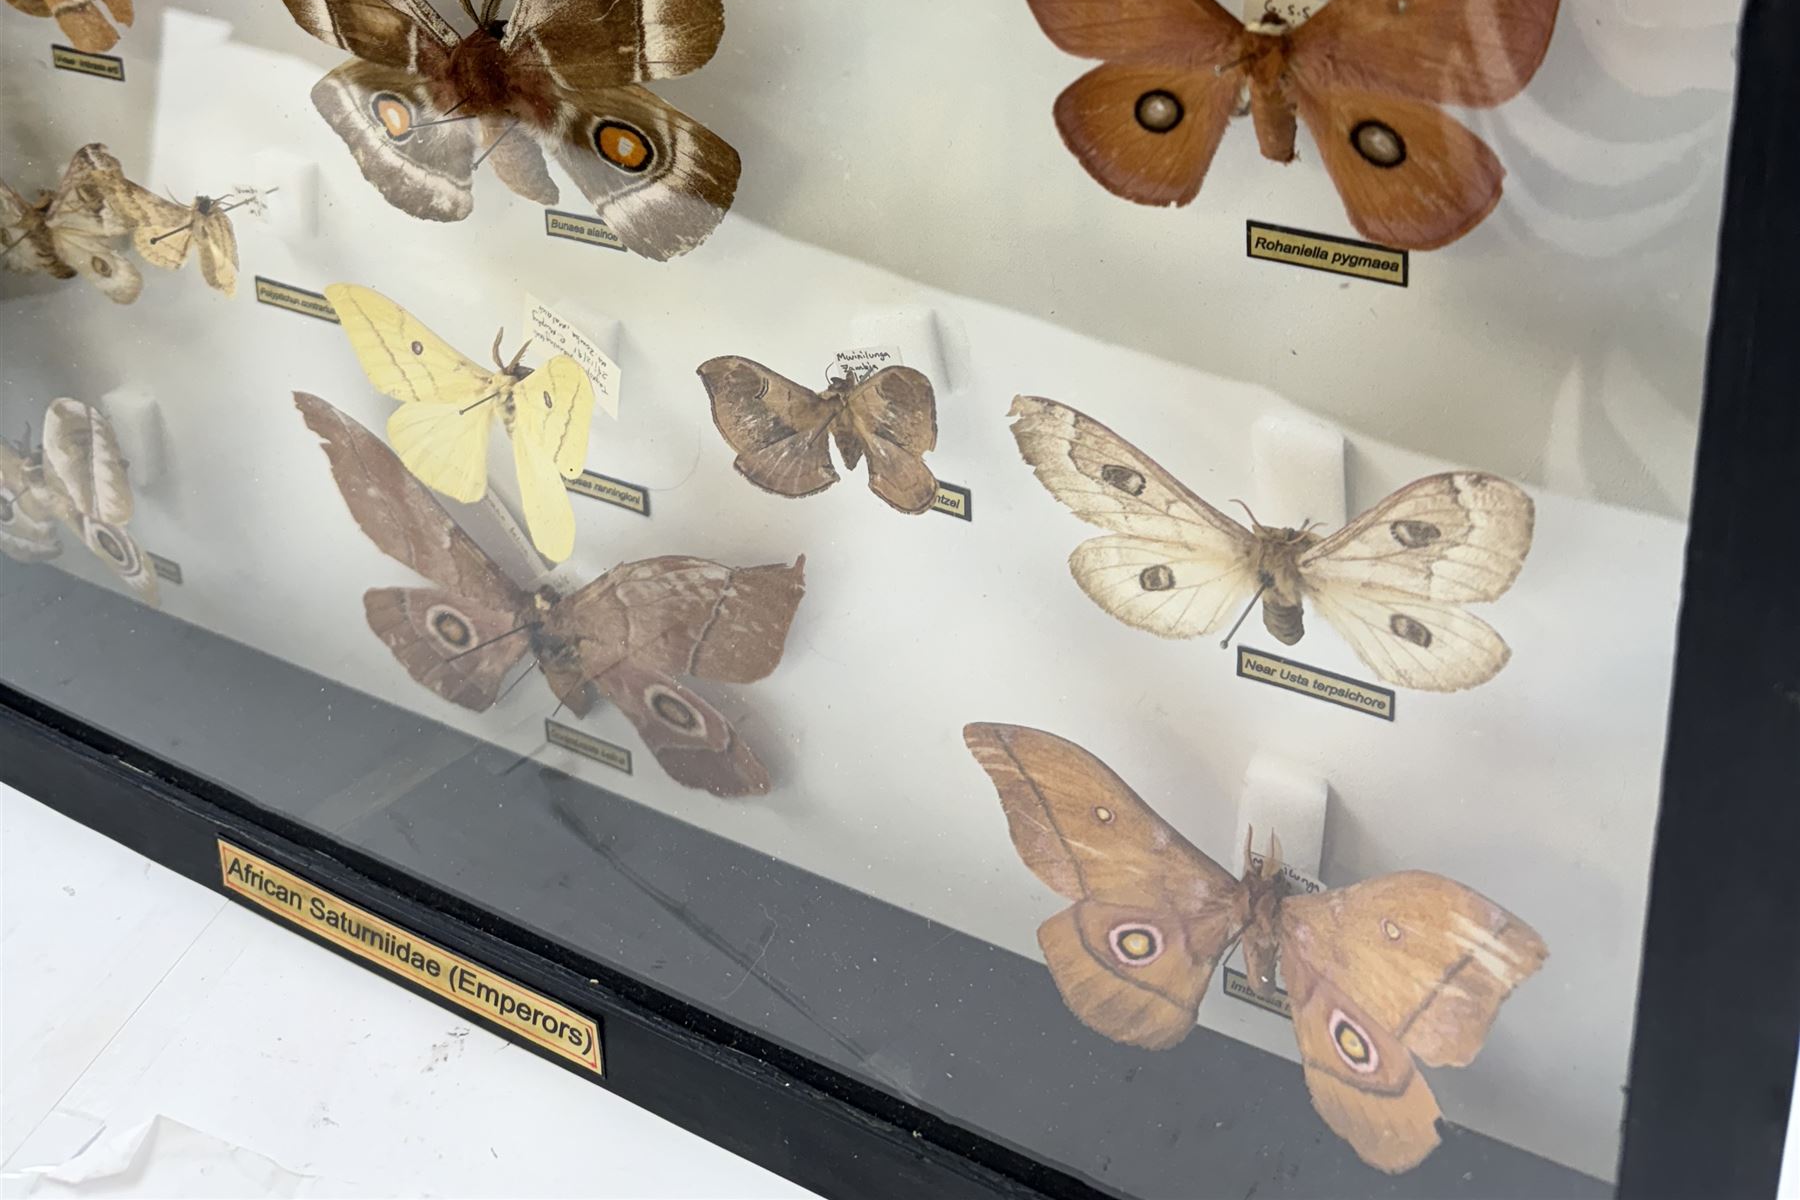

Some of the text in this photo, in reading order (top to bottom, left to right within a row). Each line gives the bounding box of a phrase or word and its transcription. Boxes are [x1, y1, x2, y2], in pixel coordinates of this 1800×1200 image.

[551, 219, 584, 234] Bunaea
[1254, 236, 1400, 273] Rohaniella pygmaea
[1245, 659, 1387, 711] Near Usta terpsichore
[227, 857, 594, 1056] African Saturniidae (Emperors)
